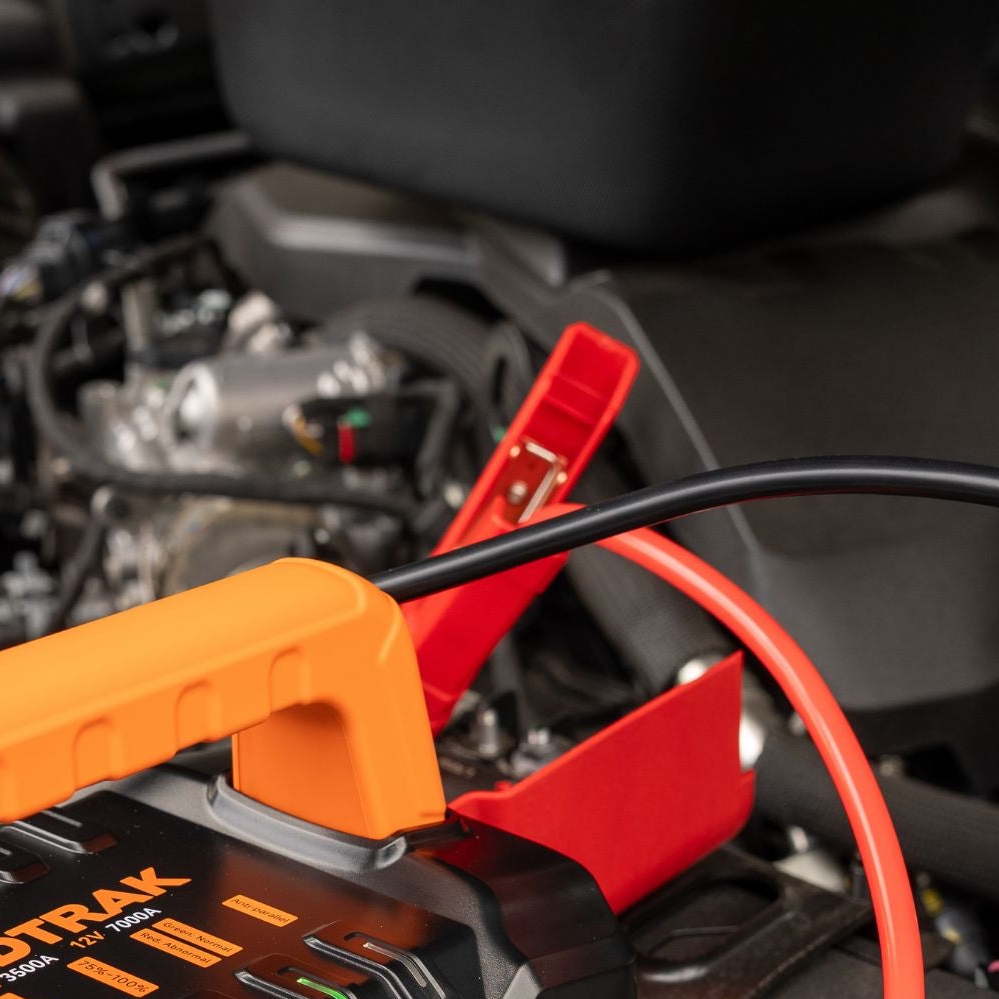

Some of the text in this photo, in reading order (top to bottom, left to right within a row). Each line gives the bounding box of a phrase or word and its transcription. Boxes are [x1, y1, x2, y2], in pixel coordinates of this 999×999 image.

[70, 907, 162, 949] 12V 7000A
[163, 941, 212, 964] Abnormal
[196, 935, 234, 953] Normal
[0, 955, 60, 982] 3500A
[77, 960, 147, 993] 75%-100%
